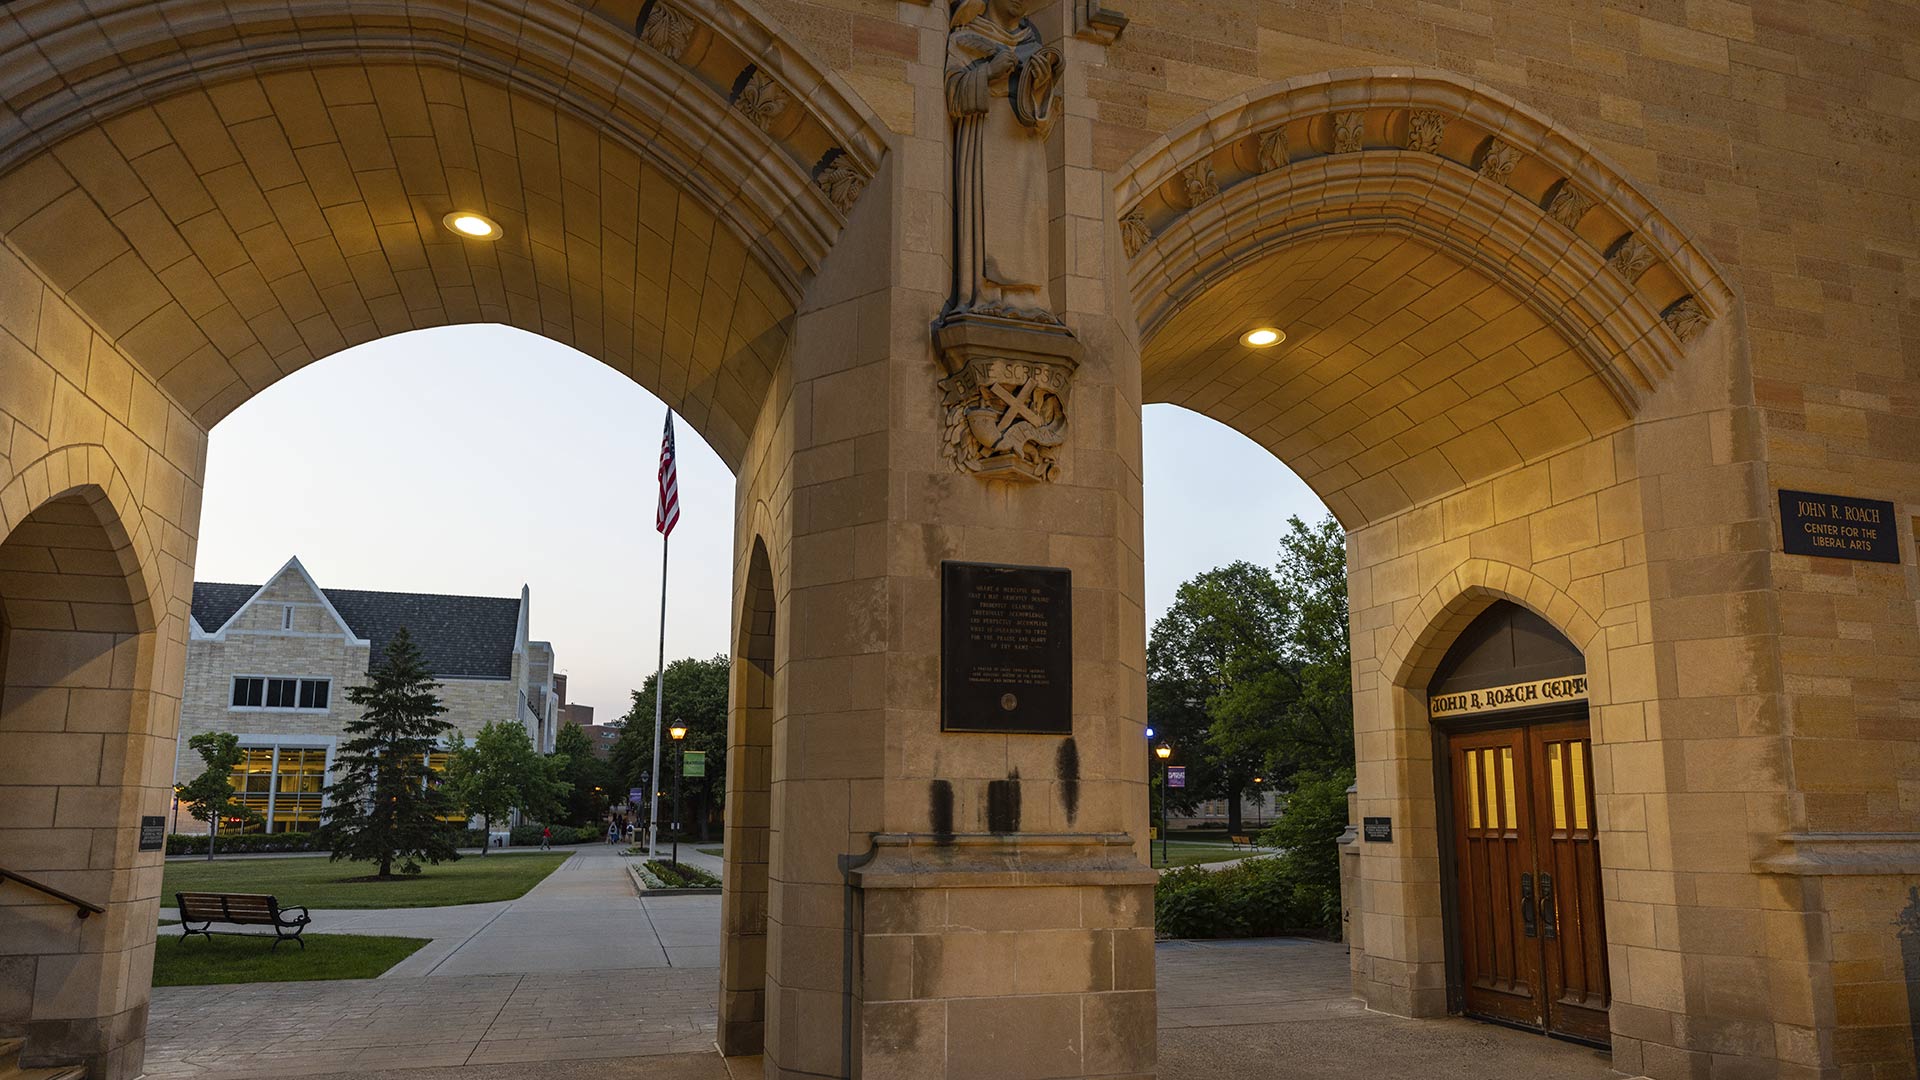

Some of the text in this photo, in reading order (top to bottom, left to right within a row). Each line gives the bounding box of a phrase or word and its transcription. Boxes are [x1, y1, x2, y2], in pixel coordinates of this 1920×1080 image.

[1798, 501, 1880, 524] JOHN R. ROACH
[1804, 523, 1877, 540] CENTER FOR THE
[1812, 536, 1872, 552] LIBERAL ARTS
[1432, 693, 1467, 713] JOHN
[1470, 692, 1483, 709] R.
[1486, 684, 1538, 709] ROACH
